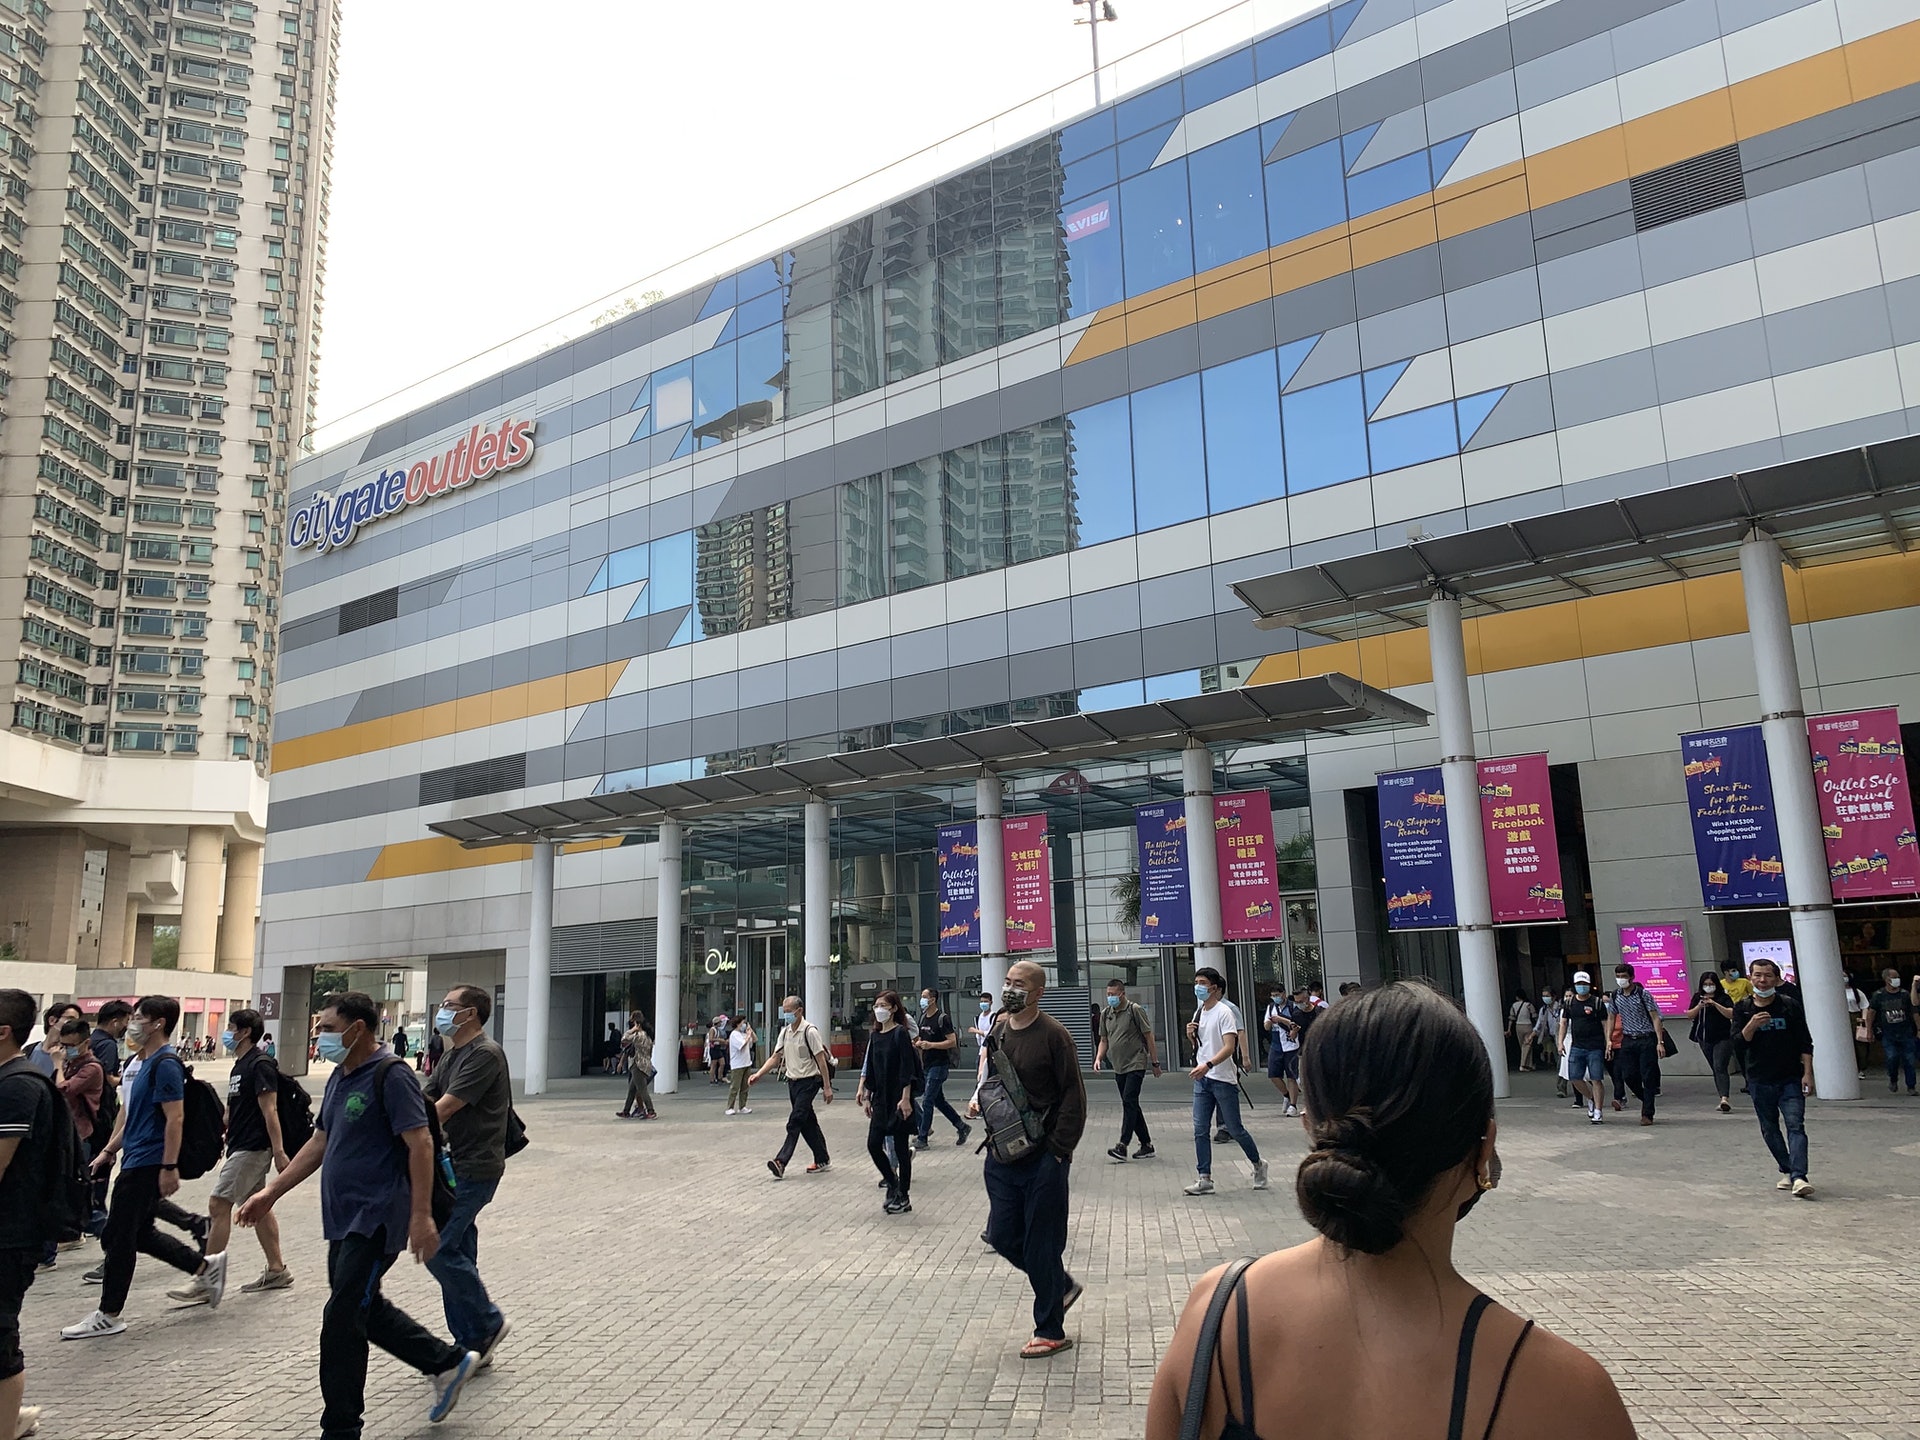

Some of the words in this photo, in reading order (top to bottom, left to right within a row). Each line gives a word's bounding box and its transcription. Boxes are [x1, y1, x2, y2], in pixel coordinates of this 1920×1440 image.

[1840, 745, 1858, 753] Sale
[1881, 746, 1899, 754] Sale
[1686, 764, 1703, 775] Sale
[1704, 760, 1721, 770] Sale
[1703, 784, 1730, 794] Share
[1732, 782, 1752, 791] Fun
[1823, 777, 1867, 793] Outlet
[1869, 773, 1900, 788] Sale
[1481, 787, 1495, 795] Sale
[1497, 787, 1511, 796] Sale
[1833, 786, 1893, 805] Carnival
[1709, 796, 1724, 807] for
[1726, 794, 1749, 803] More
[1492, 803, 1540, 818] 友樂同賞
[1697, 805, 1737, 817] Facebook
[1739, 804, 1766, 813] Game
[1216, 820, 1229, 829] Sale
[1230, 817, 1241, 825] Sale
[1384, 819, 1404, 829] Daily
[1406, 817, 1442, 827] Shopping
[1491, 817, 1545, 830] Facebook
[1730, 818, 1755, 826] HK$300
[1397, 827, 1430, 838] Rewards
[1506, 830, 1531, 843] 遊戲
[1228, 834, 1264, 847] 日日狂賞
[1898, 836, 1916, 846] Sale
[1408, 845, 1436, 853] designated
[1148, 857, 1167, 866] Outlet
[1167, 856, 1180, 865] Sale
[1743, 862, 1761, 871] Sale
[1763, 863, 1779, 872] Sale
[1831, 867, 1848, 877] Sale
[1850, 861, 1868, 873] Sale
[1869, 857, 1888, 869] Sale
[942, 870, 963, 880] Outlet
[964, 868, 978, 878] Sale
[1710, 874, 1727, 883] Sale
[947, 877, 974, 888] Carnival
[1529, 889, 1545, 898] Sale
[1546, 890, 1561, 899] Sale
[1247, 908, 1259, 916] Sale
[1260, 905, 1272, 913] Sale
